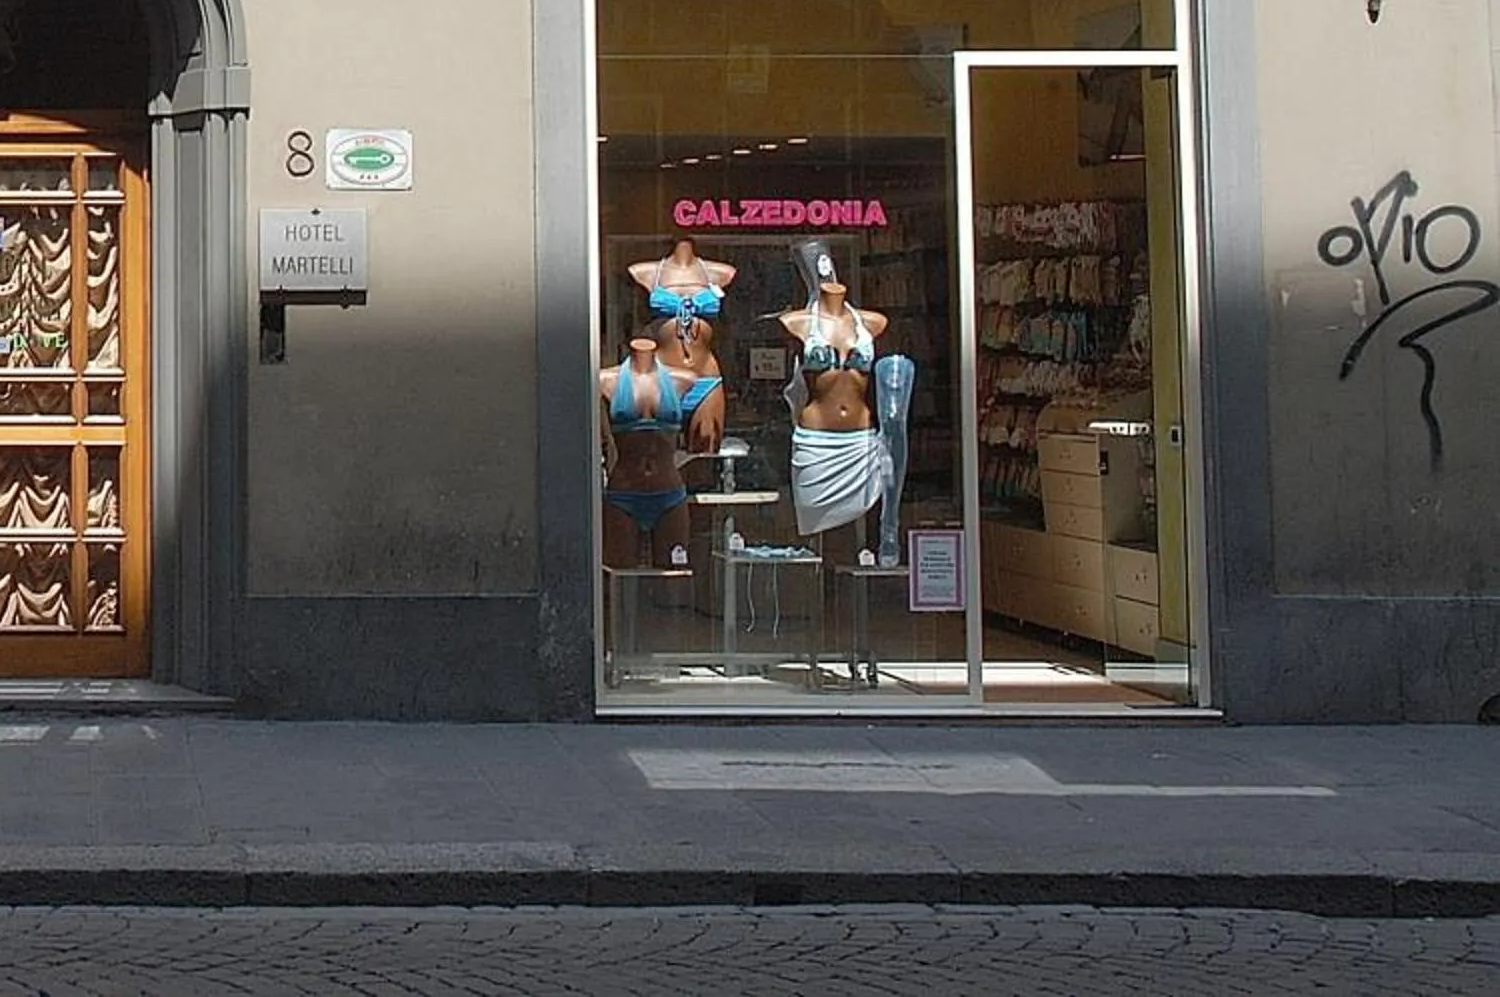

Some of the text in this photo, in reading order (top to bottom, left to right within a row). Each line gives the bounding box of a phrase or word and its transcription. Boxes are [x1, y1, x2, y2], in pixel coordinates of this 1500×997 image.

[286, 131, 314, 177] 8
[673, 200, 887, 227] CALZEDONIA
[285, 224, 345, 242] HOTEL
[272, 256, 353, 275] MARTELLI
